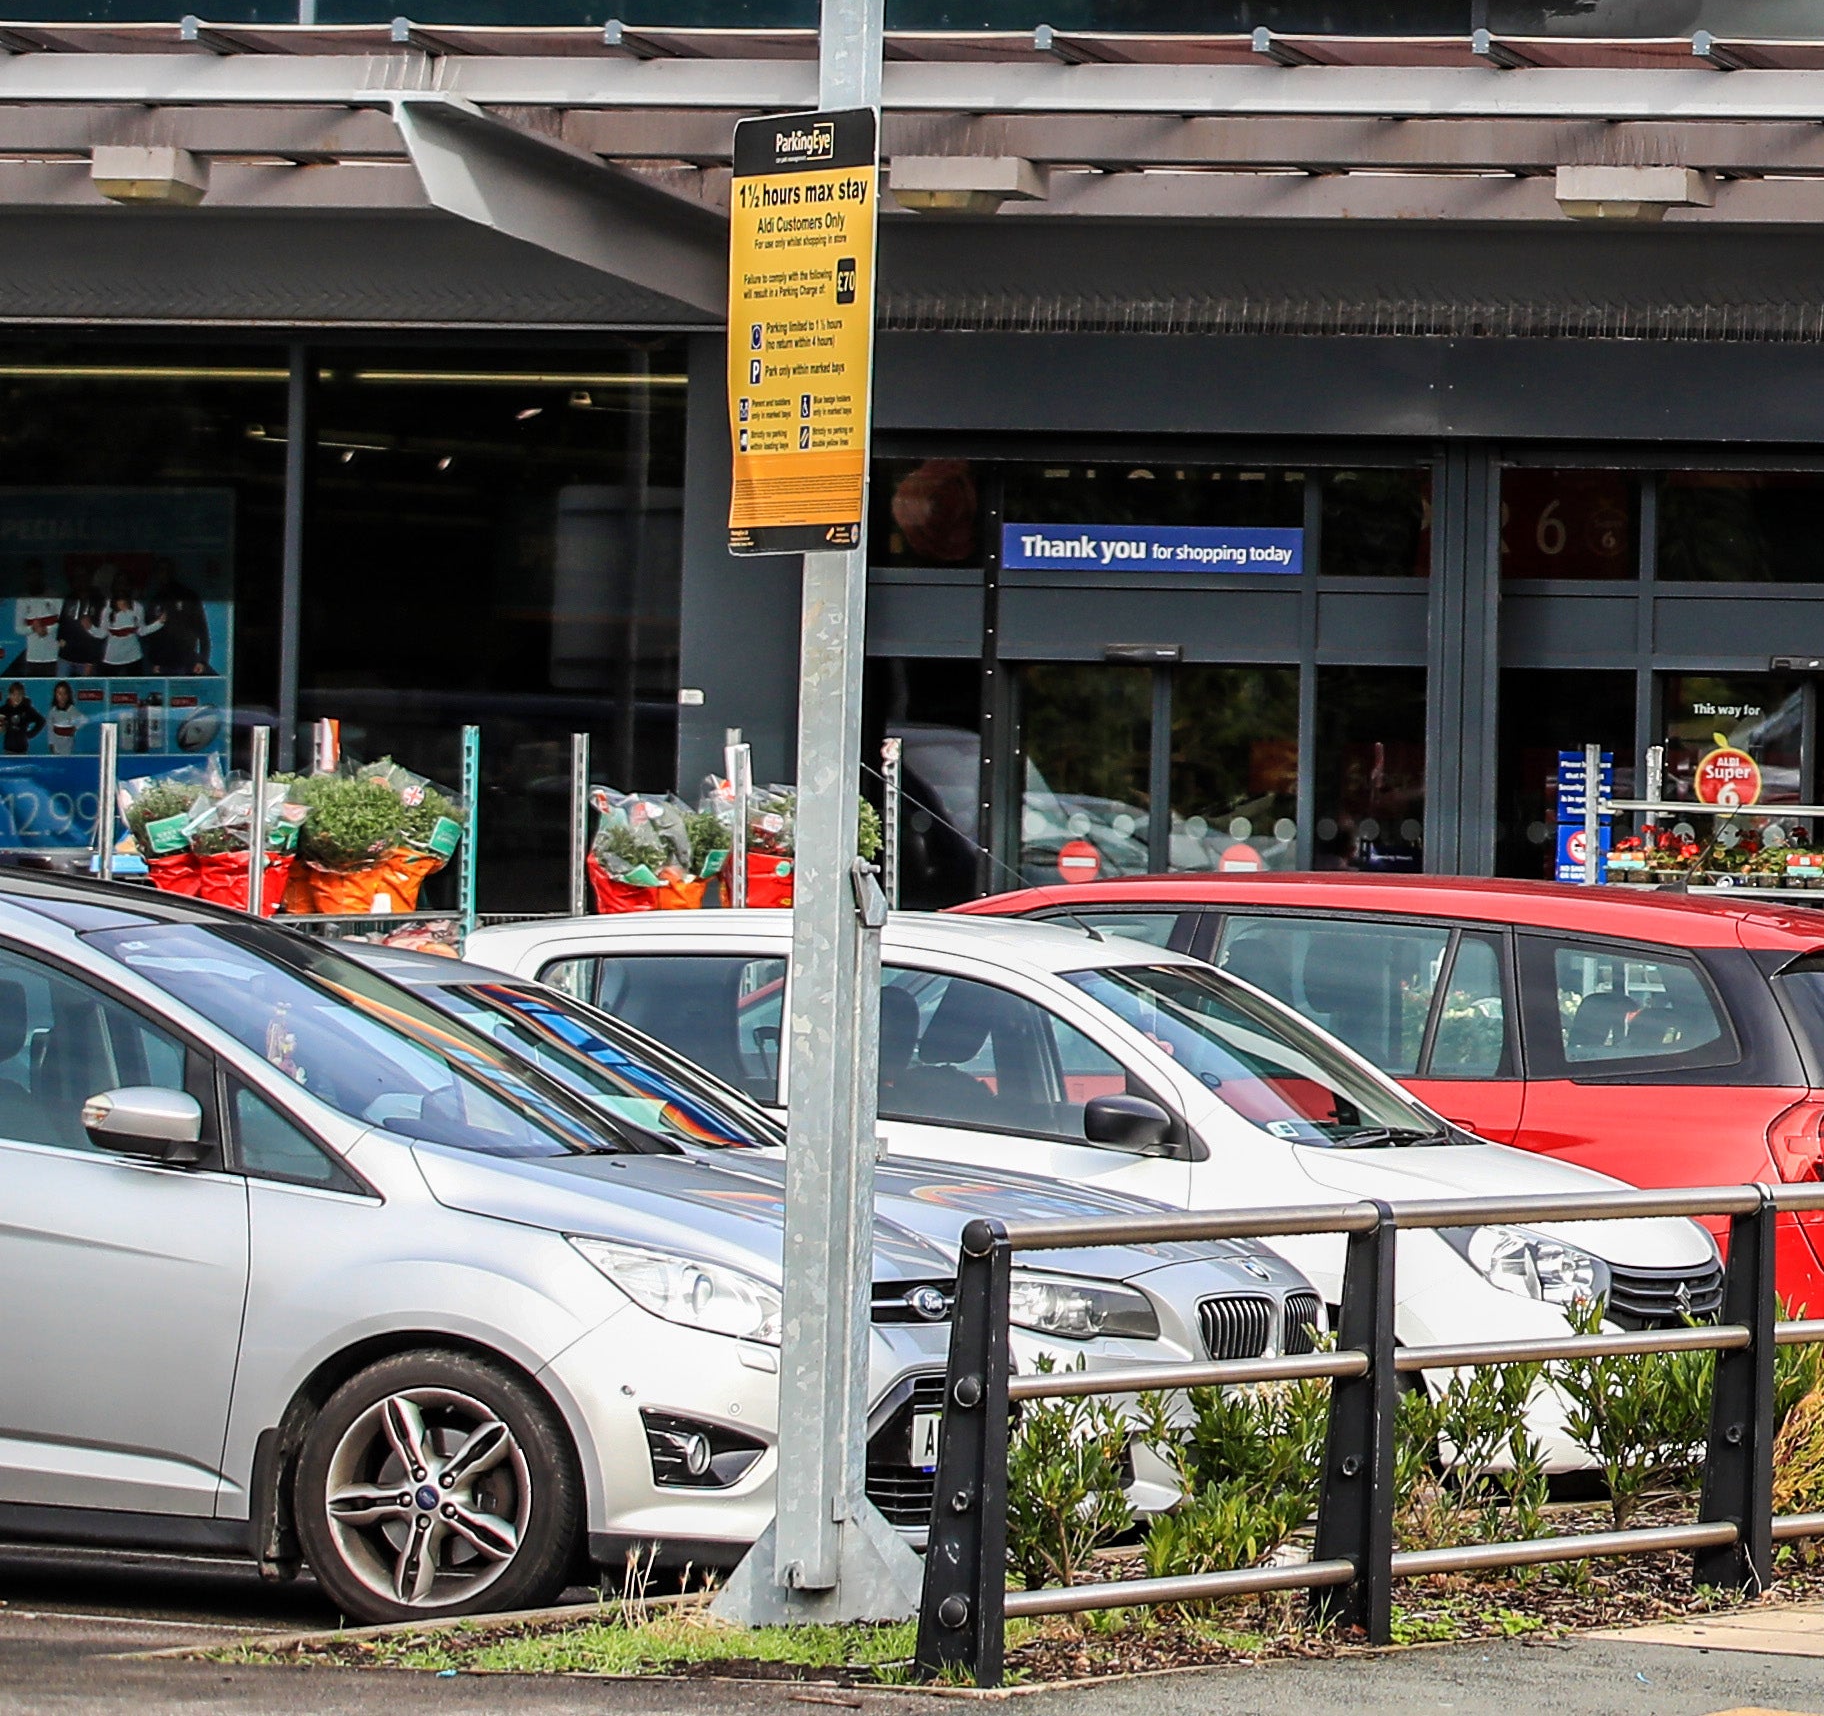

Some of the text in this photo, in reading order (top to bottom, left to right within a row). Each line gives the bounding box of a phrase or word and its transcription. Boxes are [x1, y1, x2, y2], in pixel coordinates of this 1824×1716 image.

[775, 129, 831, 155] ParkingEye
[763, 183, 801, 207] hours
[805, 183, 834, 203] max
[838, 177, 868, 205] stay
[757, 211, 846, 234] Aldi Customers Only
[754, 233, 847, 251] For use only whilst shopping in store
[744, 268, 833, 284] Failure to comply with the following
[837, 271, 855, 293] £70
[744, 289, 753, 299] will
[754, 288, 768, 299] result
[769, 288, 774, 297] in
[775, 288, 779, 297] a
[779, 285, 798, 299] Parking
[799, 285, 818, 297] Charge
[766, 322, 788, 335] Parking
[788, 321, 808, 332] limited
[808, 321, 815, 331] to
[826, 319, 843, 330] hours
[776, 338, 794, 349] return
[794, 336, 811, 348] within
[812, 336, 816, 347] 4
[752, 361, 760, 383] P
[765, 362, 845, 378] Park only within marked bays
[1536, 498, 1567, 556] 6
[1021, 535, 1293, 566] Thank you for shopping today
[1693, 703, 1761, 718] This way for
[1560, 760, 1581, 769] Please
[1716, 757, 1740, 767] ALDI
[1565, 772, 1580, 780] that
[1705, 765, 1751, 782] Super
[1558, 783, 1585, 793] Security
[1716, 782, 1740, 806] 6
[0, 792, 98, 836] 12.99
[924, 1292, 944, 1310] Ford
